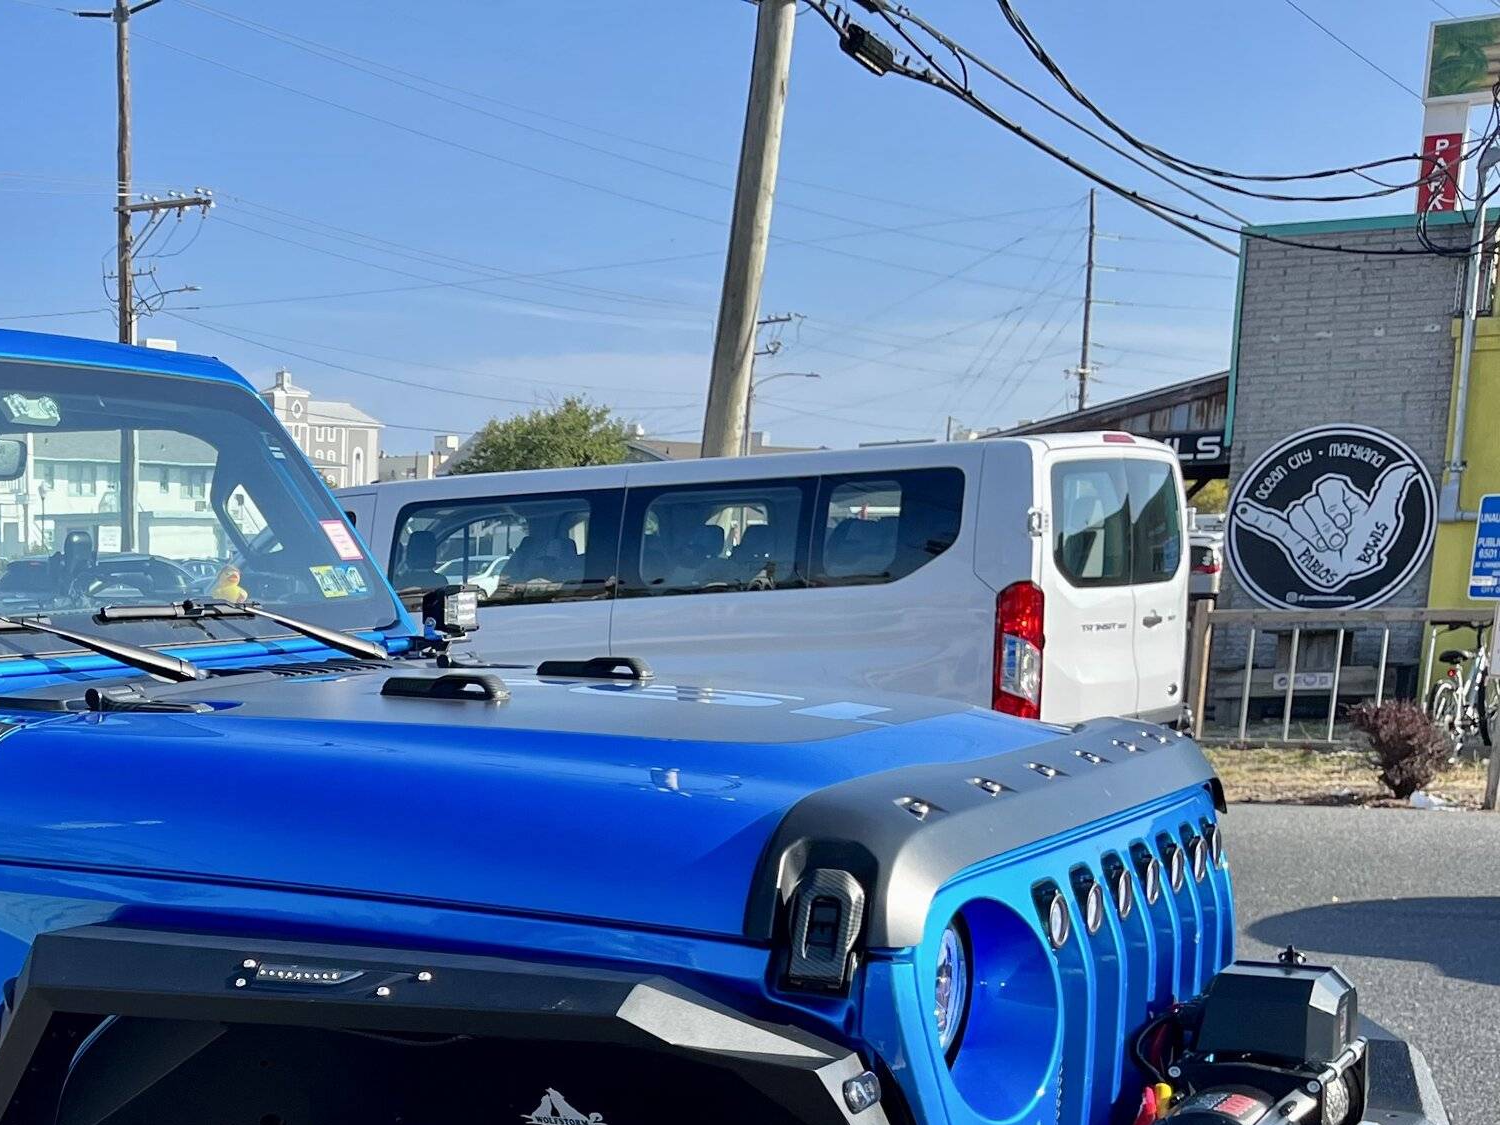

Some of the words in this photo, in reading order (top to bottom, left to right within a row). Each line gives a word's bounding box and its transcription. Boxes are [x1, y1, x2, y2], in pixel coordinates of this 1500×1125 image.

[1164, 436, 1221, 460] LS
[1355, 521, 1389, 565] BOWLS
[1297, 546, 1338, 584] PABLOS
